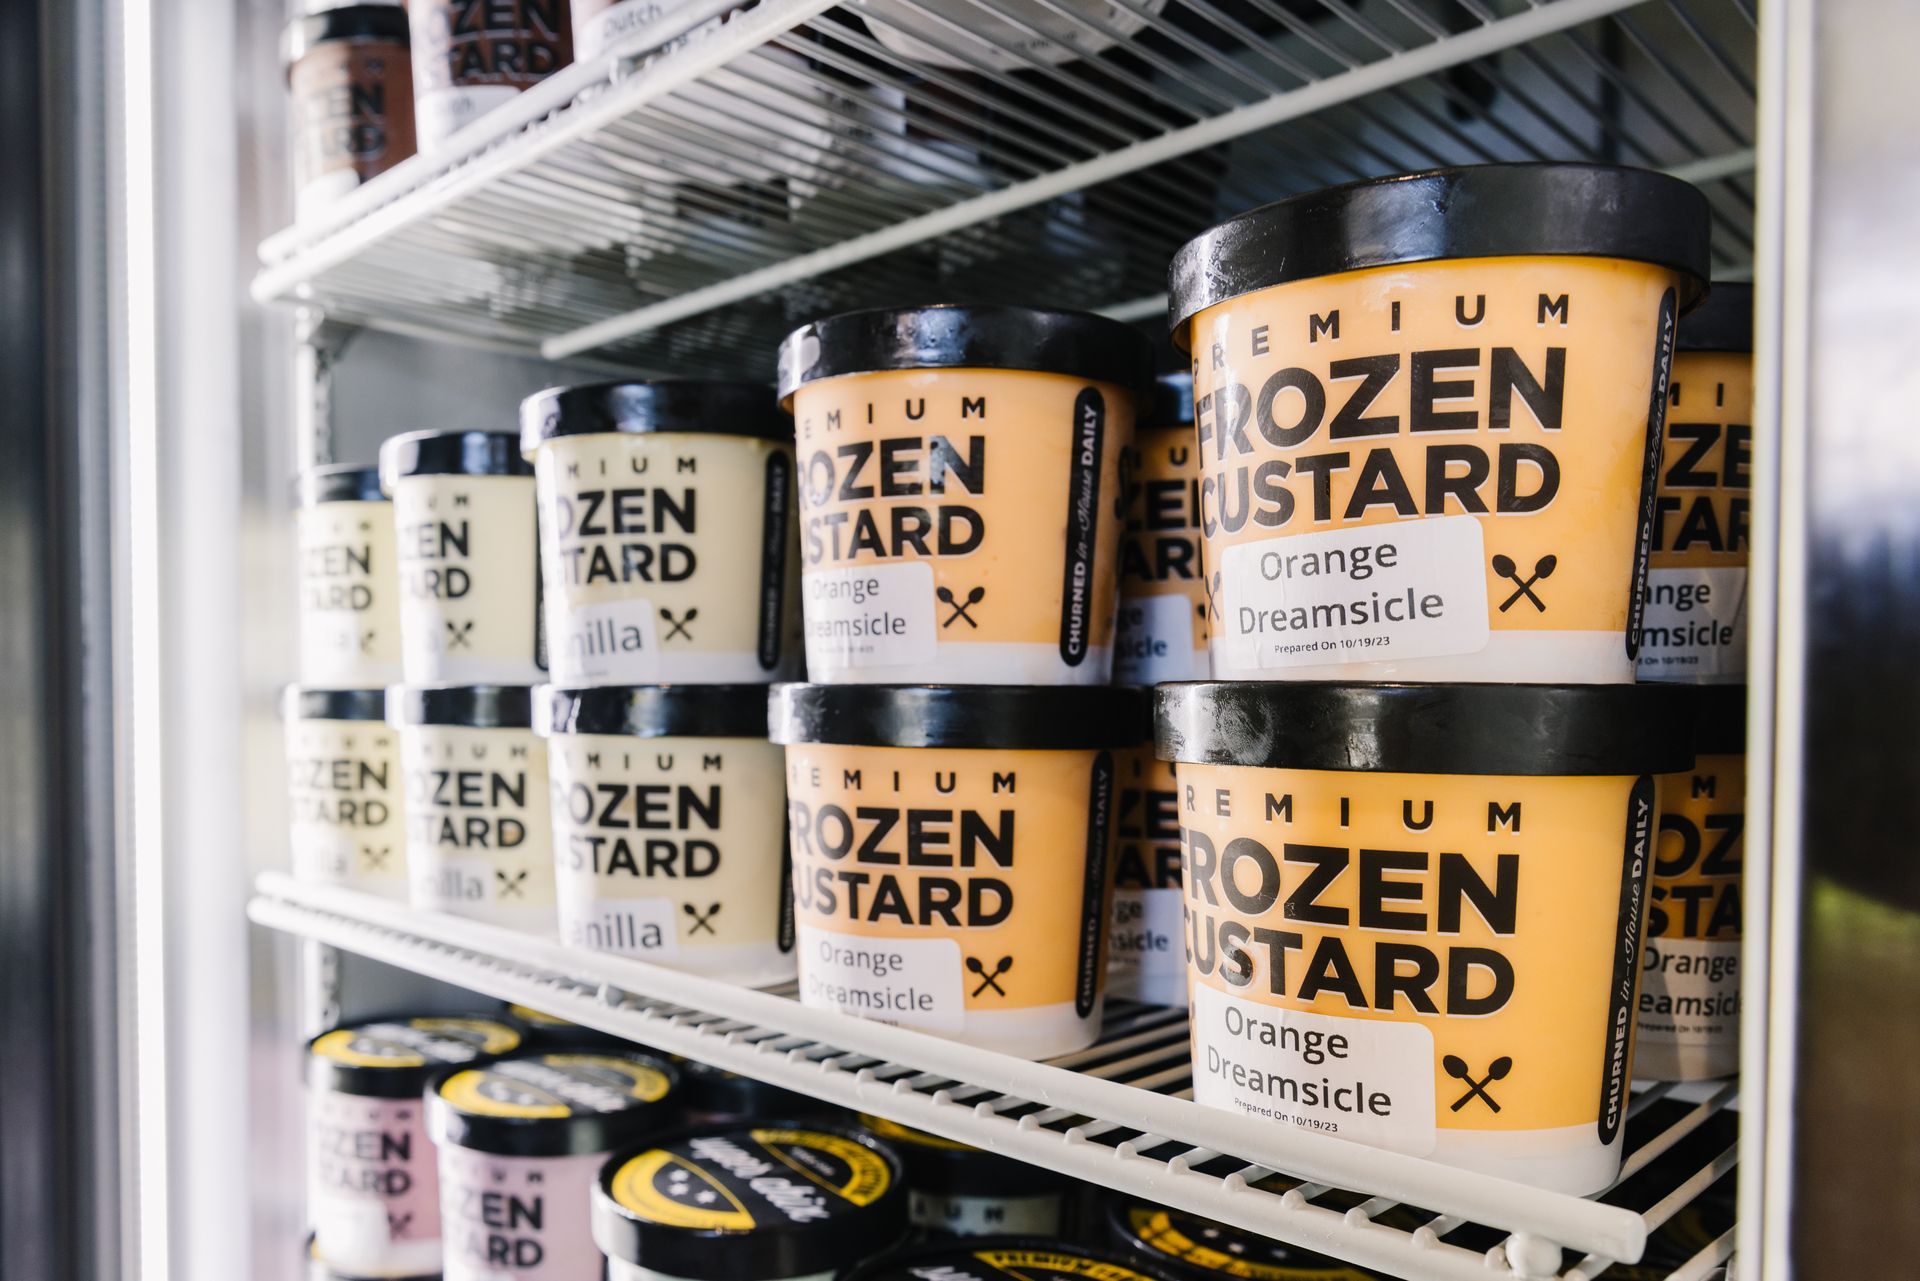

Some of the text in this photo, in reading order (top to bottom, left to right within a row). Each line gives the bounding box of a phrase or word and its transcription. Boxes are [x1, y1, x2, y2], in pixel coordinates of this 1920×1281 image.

[1193, 294, 1569, 385] PREMIUM
[1197, 347, 1567, 471] FROZEN
[1201, 443, 1562, 539] CUSTARD
[1631, 522, 1650, 646] CHURNED
[1658, 310, 1673, 394] DAILY
[804, 505, 985, 567] STARD
[1068, 561, 1086, 655] CHURNED
[1081, 405, 1098, 466] DAILY
[1260, 542, 1398, 580] Orange
[813, 578, 880, 604] Orange
[1239, 587, 1445, 635] Dreamsicle
[807, 611, 906, 637] Deamsicle
[1274, 636, 1390, 655] Prepared On 10/19/23
[430, 771, 526, 808] ZEN
[789, 800, 1016, 868] ROZEN
[794, 862, 1014, 927] USTARD
[819, 940, 903, 977] Orange
[1606, 1004, 1627, 1131] CHURNED
[1631, 798, 1649, 879] DAILY
[809, 973, 934, 1011] Dreamsicle
[1639, 990, 1742, 1017] eamsicl
[1225, 1006, 1349, 1065] Orange
[1208, 1045, 1392, 1117] Dreamsicle
[1235, 1097, 1339, 1133] Prepared On 10/19/23
